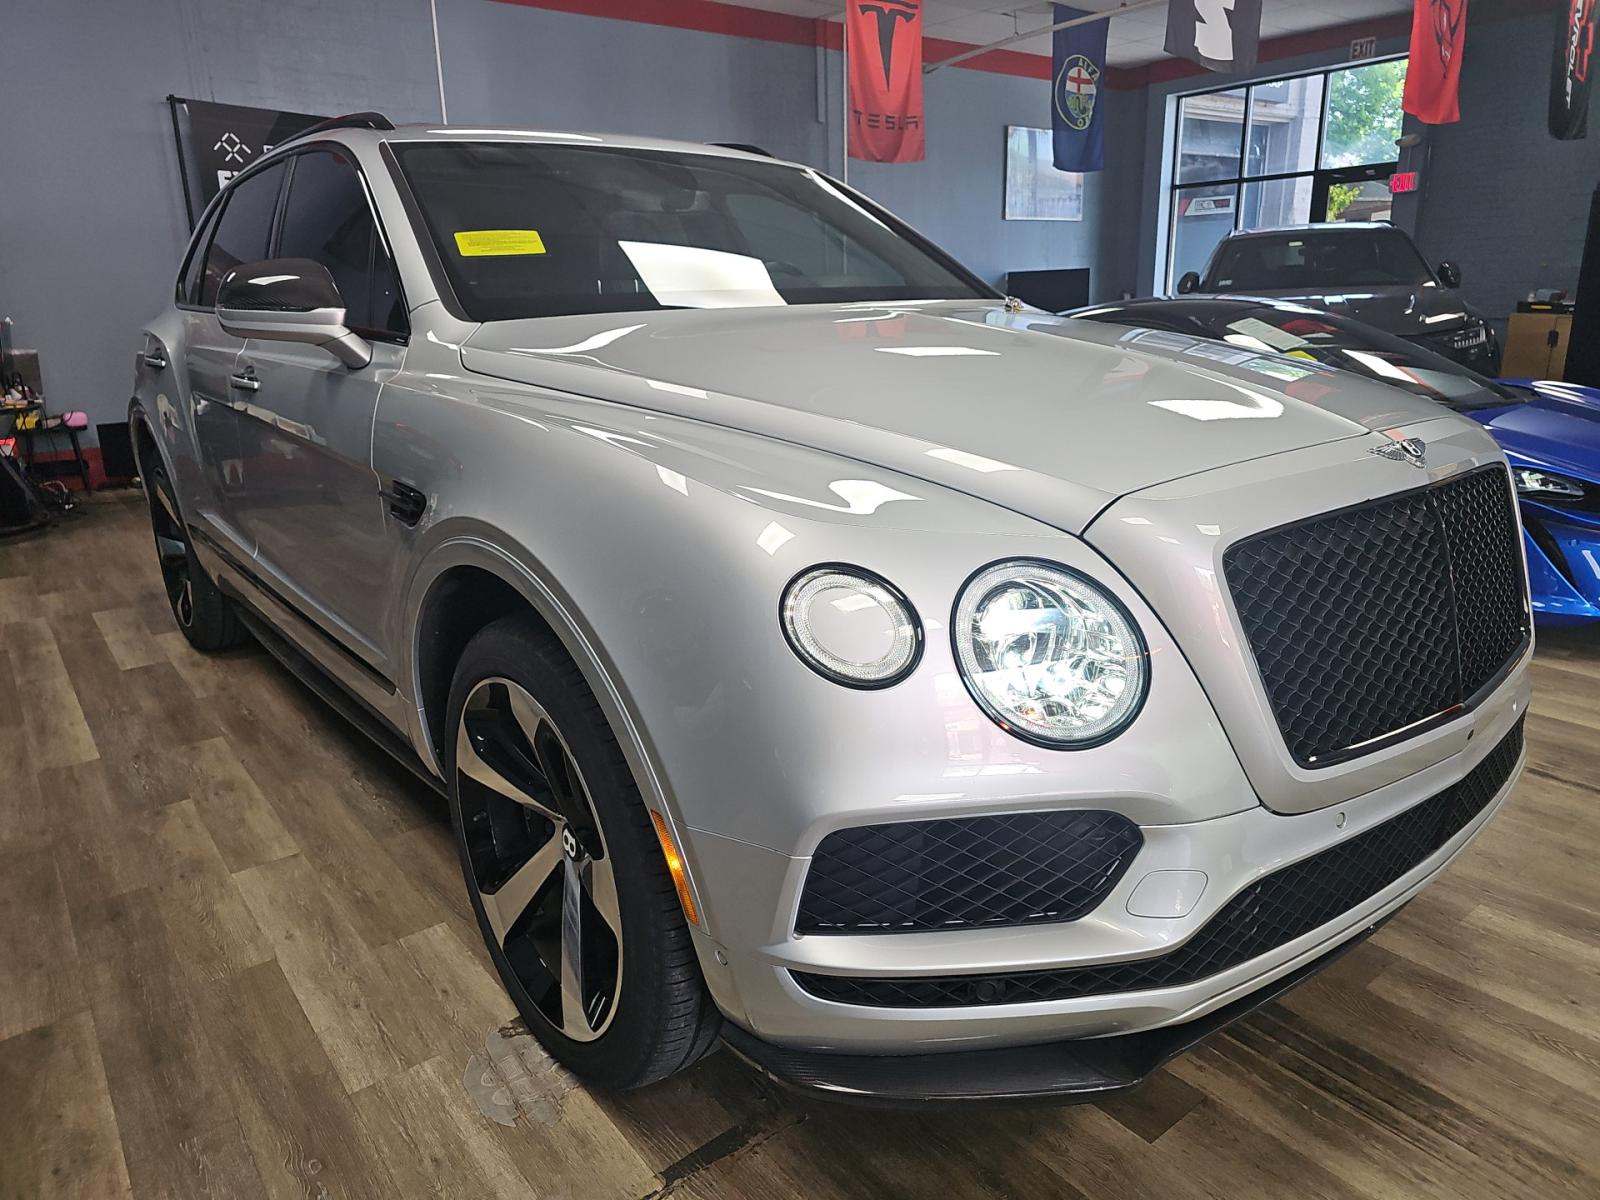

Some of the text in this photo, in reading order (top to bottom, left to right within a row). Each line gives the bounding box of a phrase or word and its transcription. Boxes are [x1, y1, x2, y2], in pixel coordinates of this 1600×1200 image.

[1353, 40, 1375, 57] EXIT
[853, 108, 919, 130] TESLA
[1393, 174, 1415, 191] EXIT
